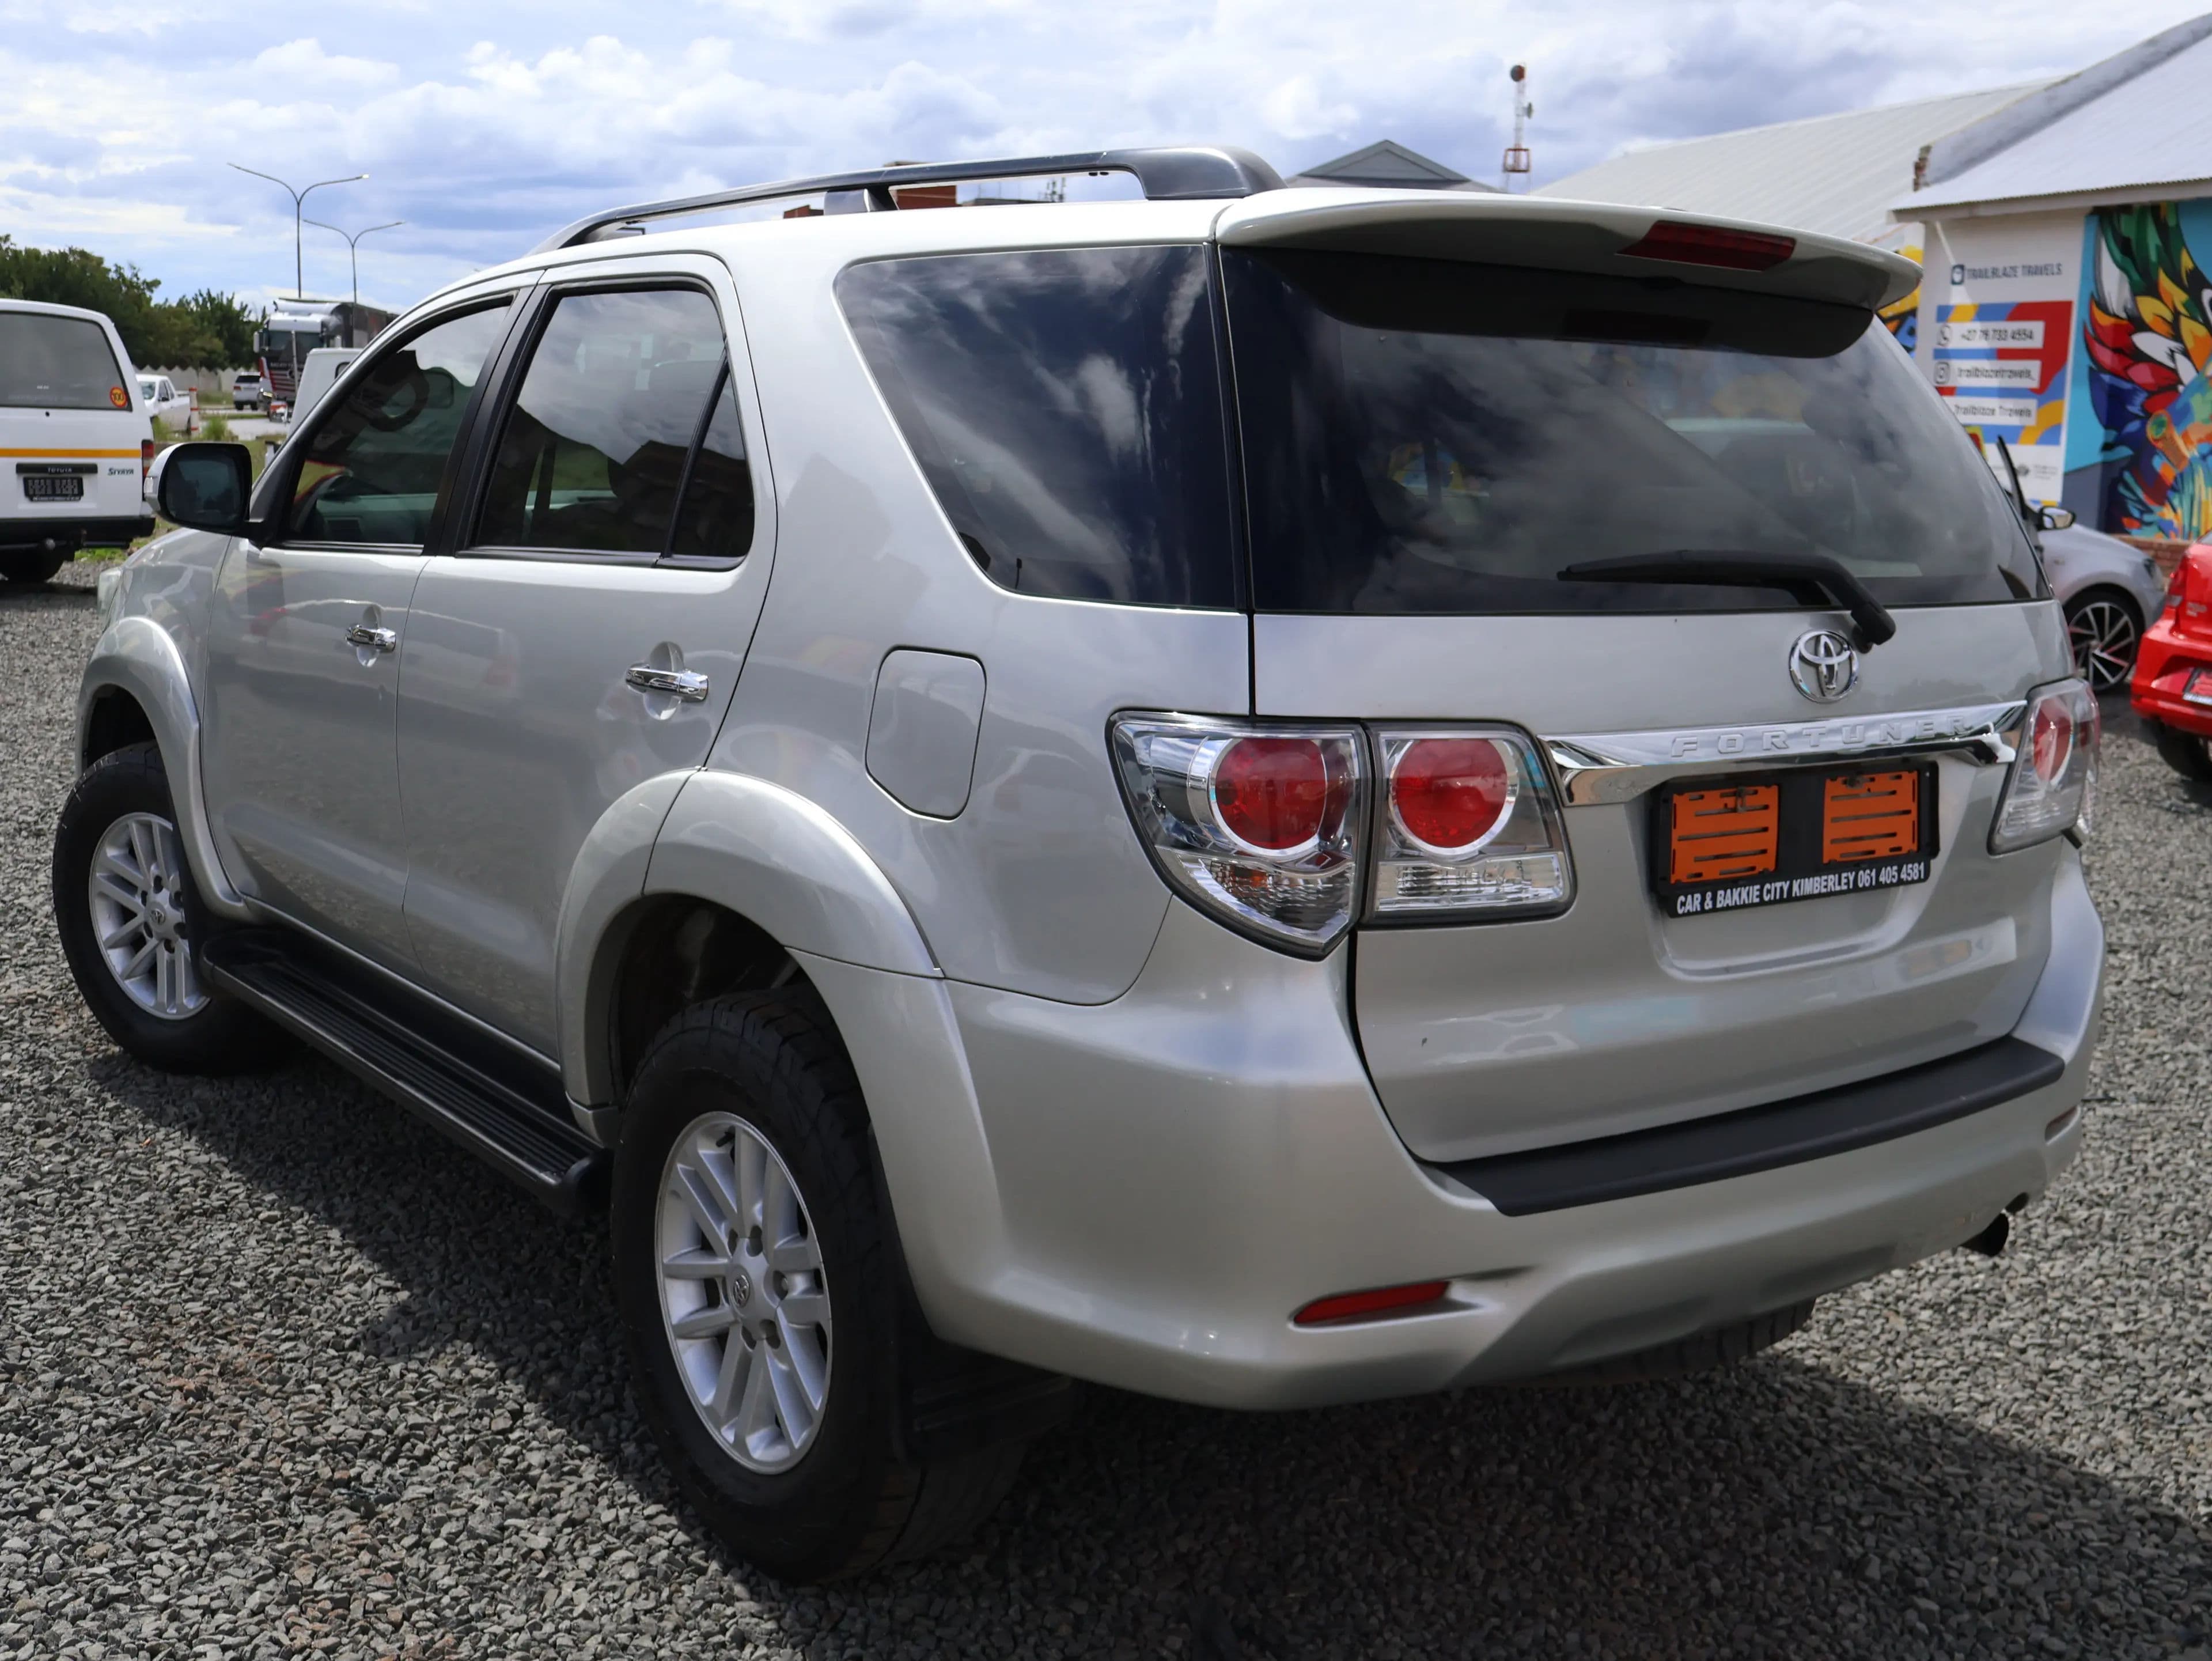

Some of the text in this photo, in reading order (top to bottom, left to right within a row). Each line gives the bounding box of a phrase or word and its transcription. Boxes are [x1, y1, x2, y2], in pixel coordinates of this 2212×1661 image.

[1966, 263, 2062, 279] TRAILBLAZE TRAVELS
[1671, 715, 1973, 758] FORTUNER
[1676, 861, 1925, 914] CAR & BAKKIE CITY KIMBERLEY 061 405 4581
